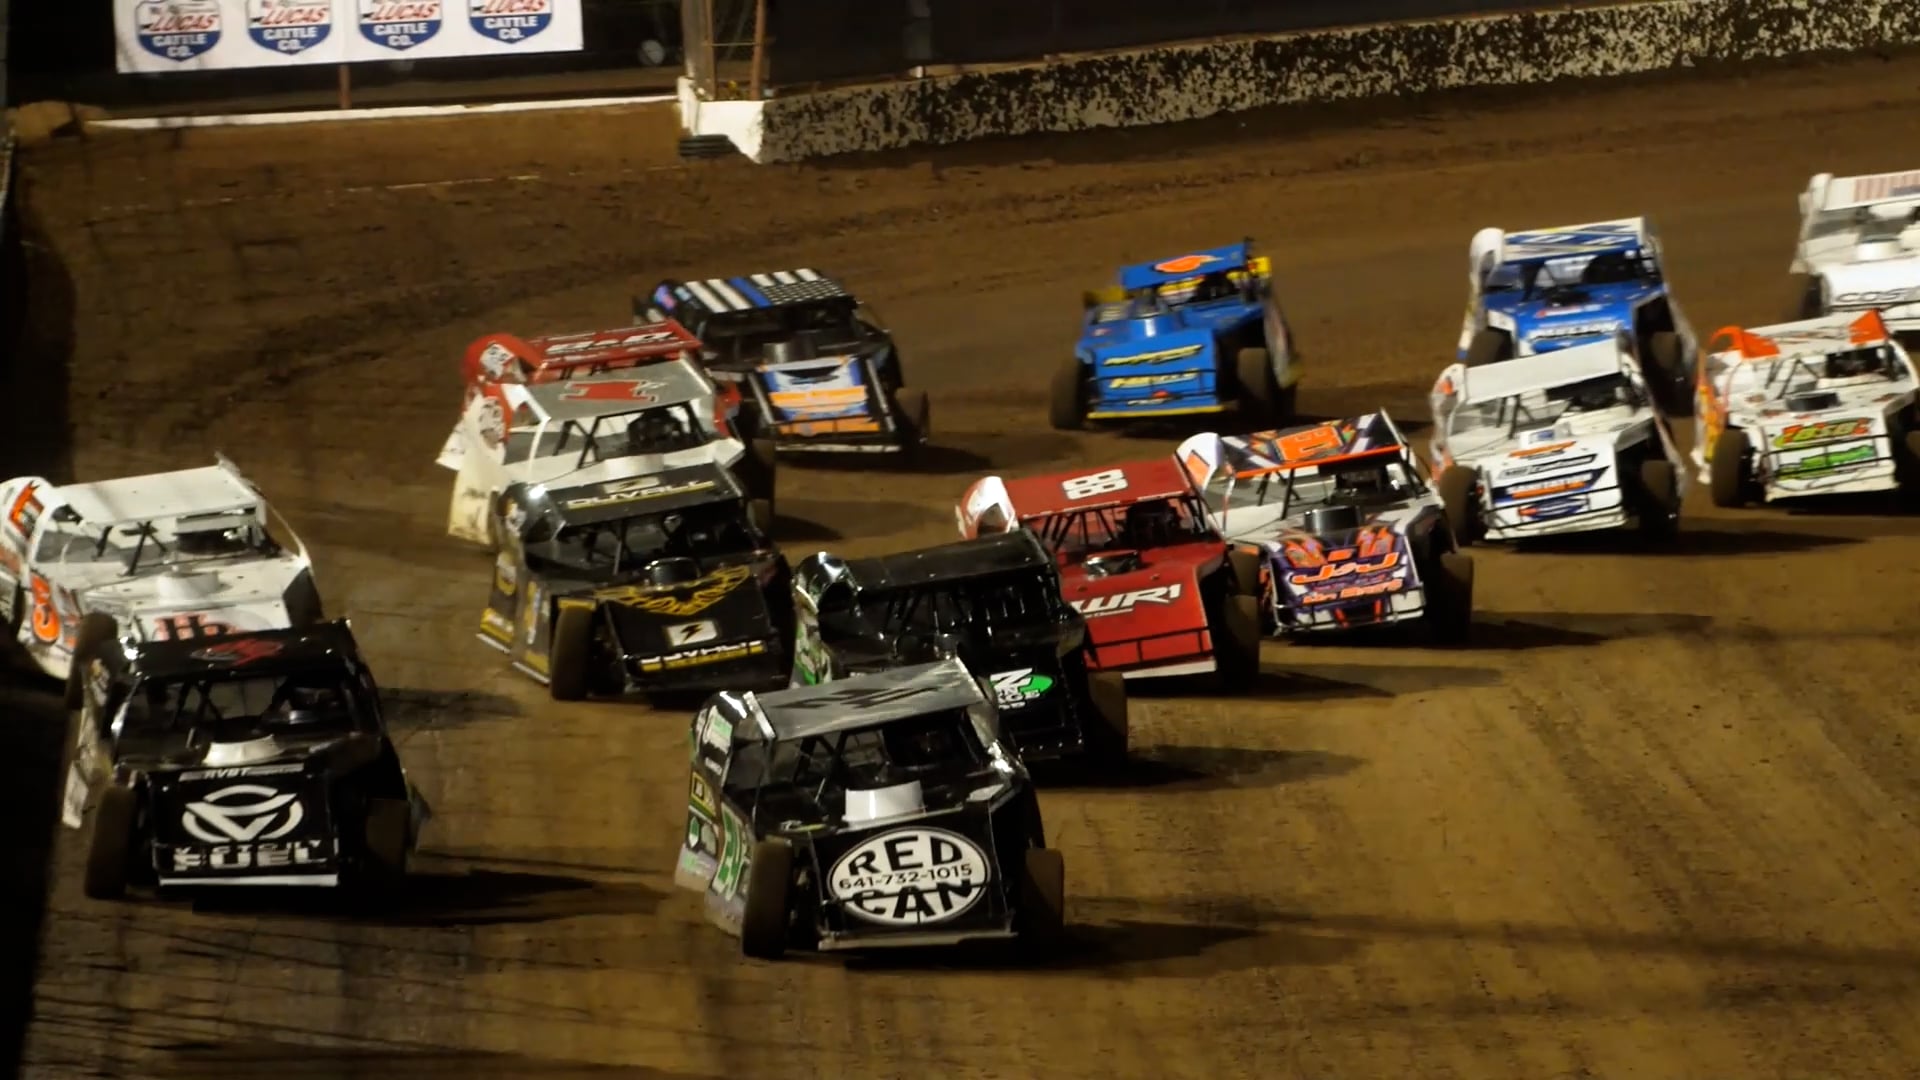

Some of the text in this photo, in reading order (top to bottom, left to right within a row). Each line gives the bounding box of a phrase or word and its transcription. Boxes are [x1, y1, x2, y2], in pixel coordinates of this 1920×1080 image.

[262, 7, 330, 26] LUCAS
[371, 2, 438, 21] LUCAS
[150, 14, 219, 32] LUCAS
[373, 22, 428, 36] CATTLE
[483, 15, 538, 29] CATTLE
[152, 33, 207, 47] CATTLE
[263, 26, 318, 40] CATTLE
[498, 28, 525, 40] CO.
[276, 39, 304, 51] CO.
[387, 34, 415, 47] CO.
[166, 46, 194, 58] CO.
[847, 834, 963, 877] RED
[838, 863, 973, 890] 641-732-1015
[850, 878, 973, 919] CAN
